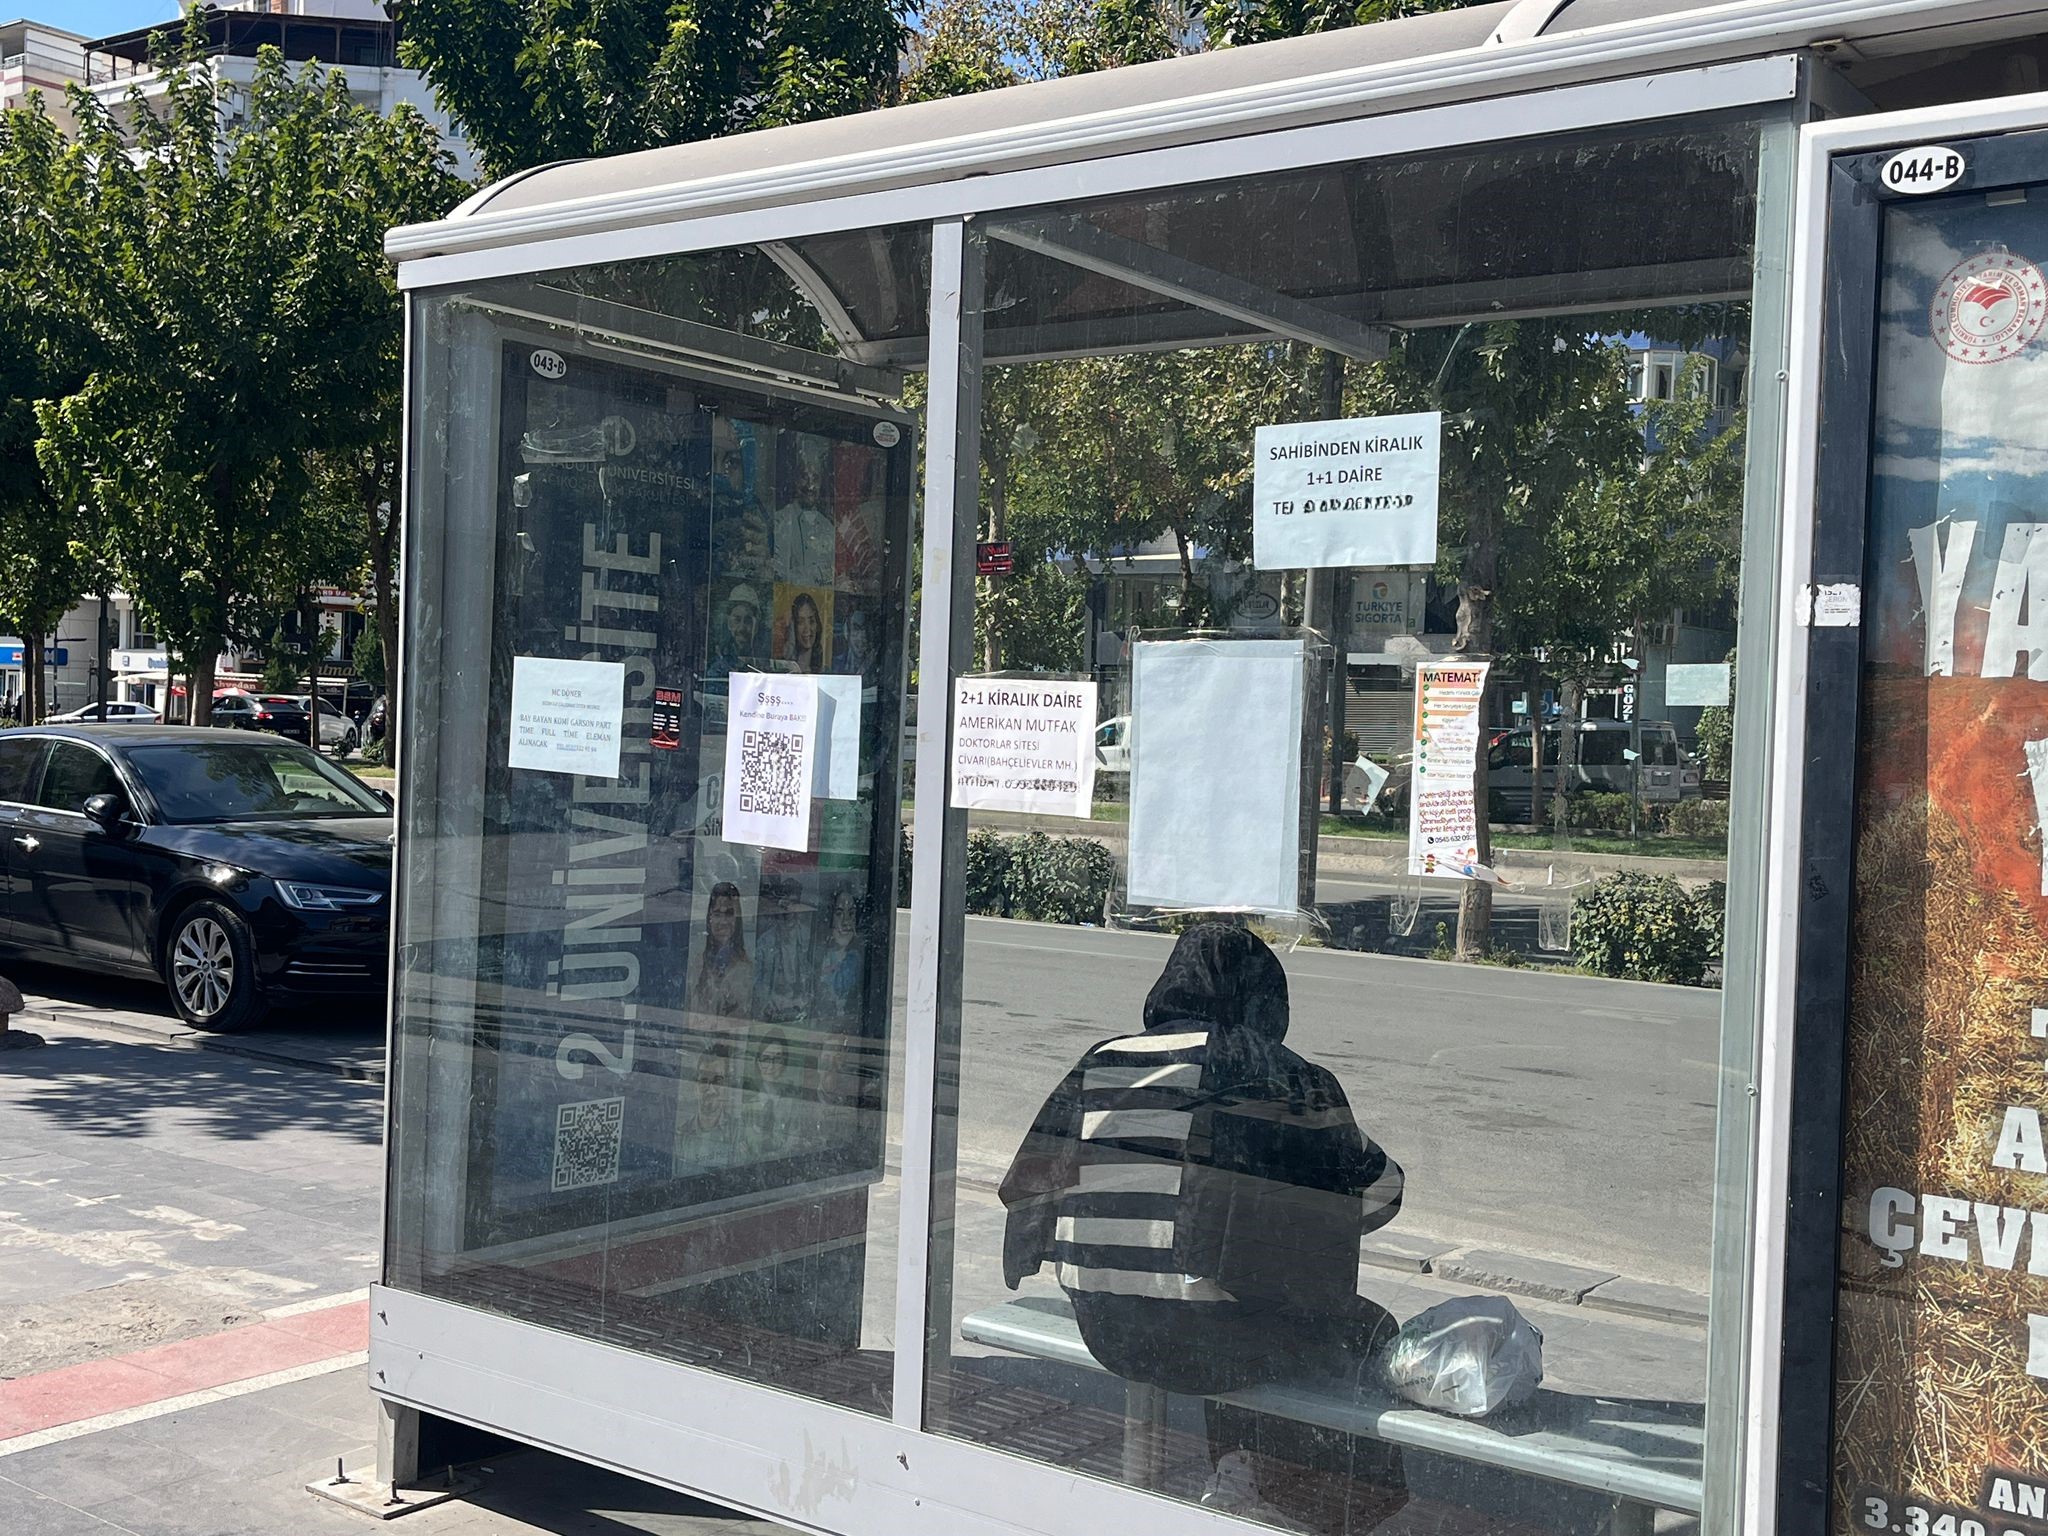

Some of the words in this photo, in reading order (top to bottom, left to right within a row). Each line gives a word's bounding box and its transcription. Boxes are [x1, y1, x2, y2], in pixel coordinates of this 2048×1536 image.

[1889, 155, 1960, 185] 044-B
[533, 353, 565, 376] 043-B
[1269, 440, 1361, 461] SAHİBİNDEN
[1365, 435, 1424, 453] KİRALIK
[1307, 471, 1333, 486] 1+1
[1338, 465, 1383, 484] DAİRE
[960, 691, 984, 706] 2+1
[988, 688, 1040, 707] KİRALIK
[1043, 690, 1083, 709] DAİRE
[959, 714, 1022, 731] AMERİKAN
[1025, 719, 1077, 734] MUTFAK
[959, 737, 1012, 750] DOKTORLAR
[1013, 739, 1040, 751] SİTESİ
[1055, 760, 1078, 773] MH.)
